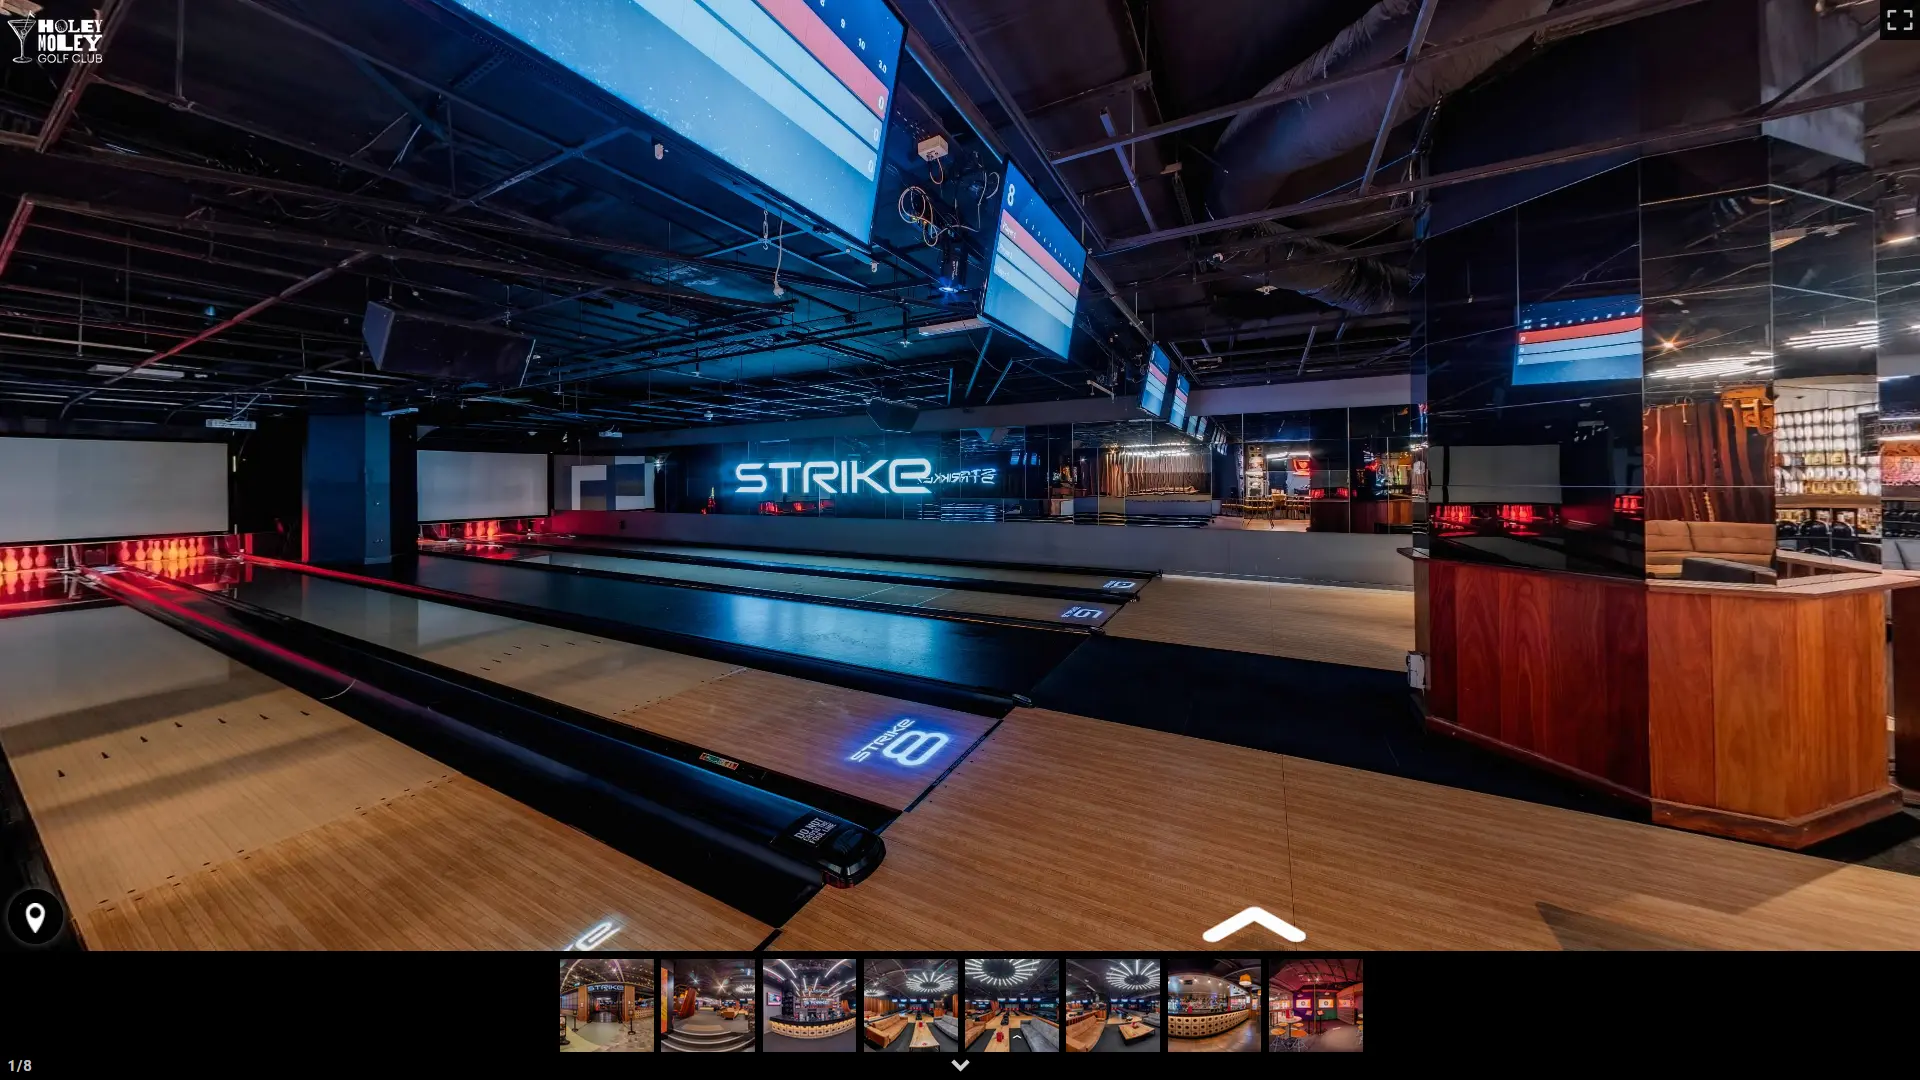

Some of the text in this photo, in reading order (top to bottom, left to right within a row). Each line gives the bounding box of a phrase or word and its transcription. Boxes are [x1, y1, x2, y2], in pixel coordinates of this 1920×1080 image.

[841, 18, 845, 28] 9
[878, 95, 884, 110] 0
[873, 127, 879, 142] 0
[867, 159, 874, 173] 0
[1008, 184, 1015, 206] 8
[734, 458, 932, 494] STRIKE
[850, 718, 915, 763] STRIKE
[882, 730, 949, 766] 8
[794, 818, 823, 839] DO NOT
